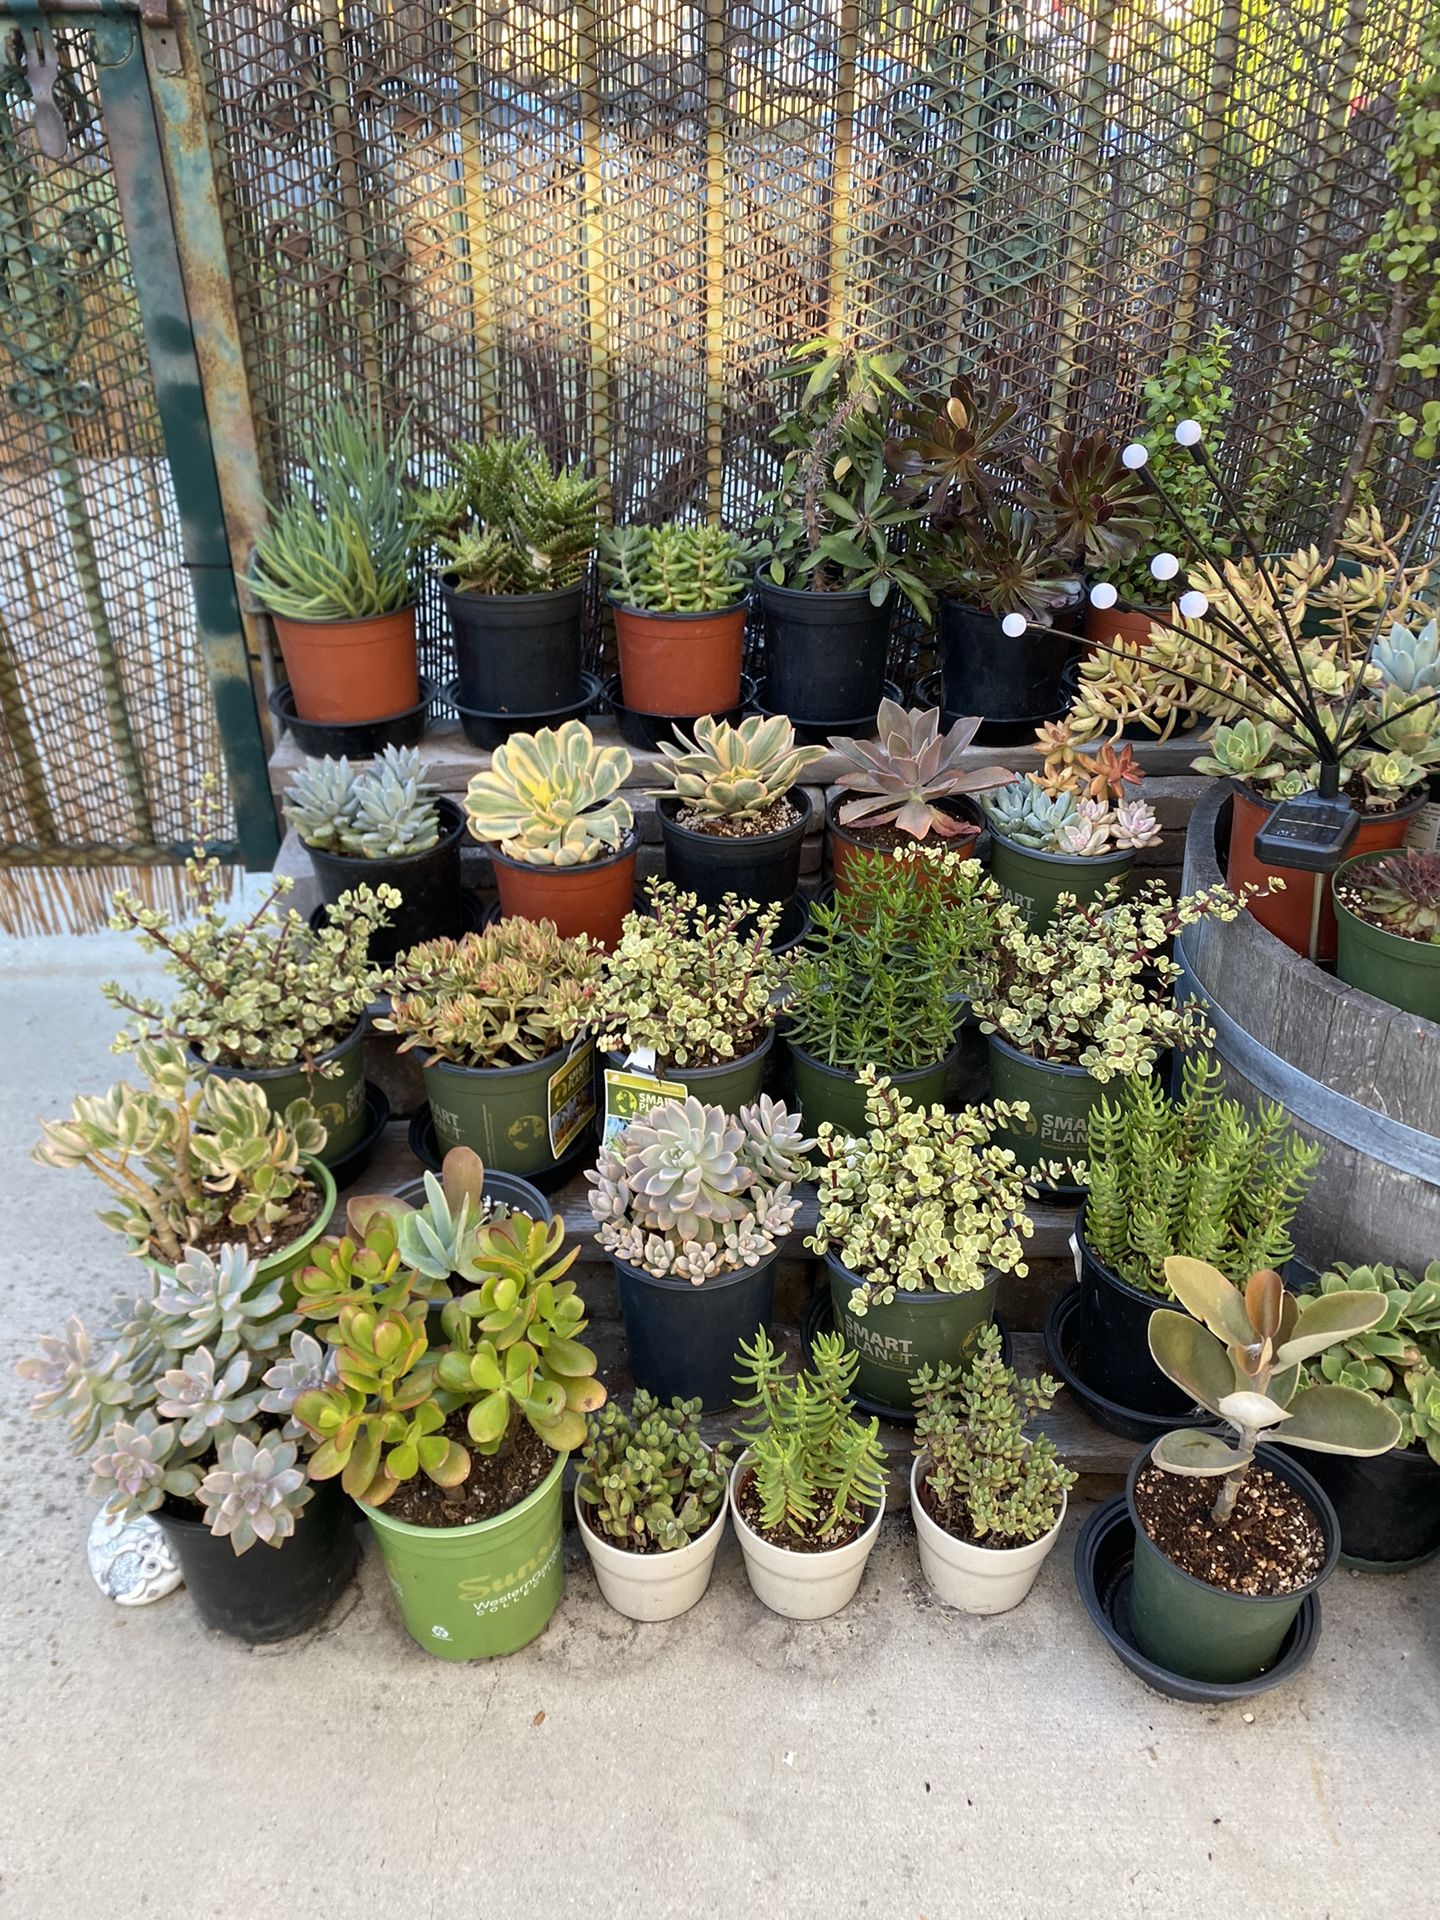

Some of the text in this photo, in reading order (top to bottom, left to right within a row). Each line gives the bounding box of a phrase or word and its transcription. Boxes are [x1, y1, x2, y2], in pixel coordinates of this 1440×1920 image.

[639, 1092, 670, 1108] SMA
[1042, 1113, 1087, 1132] SMA
[1041, 1127, 1088, 1144] PLAN
[845, 1314, 913, 1353] SMART
